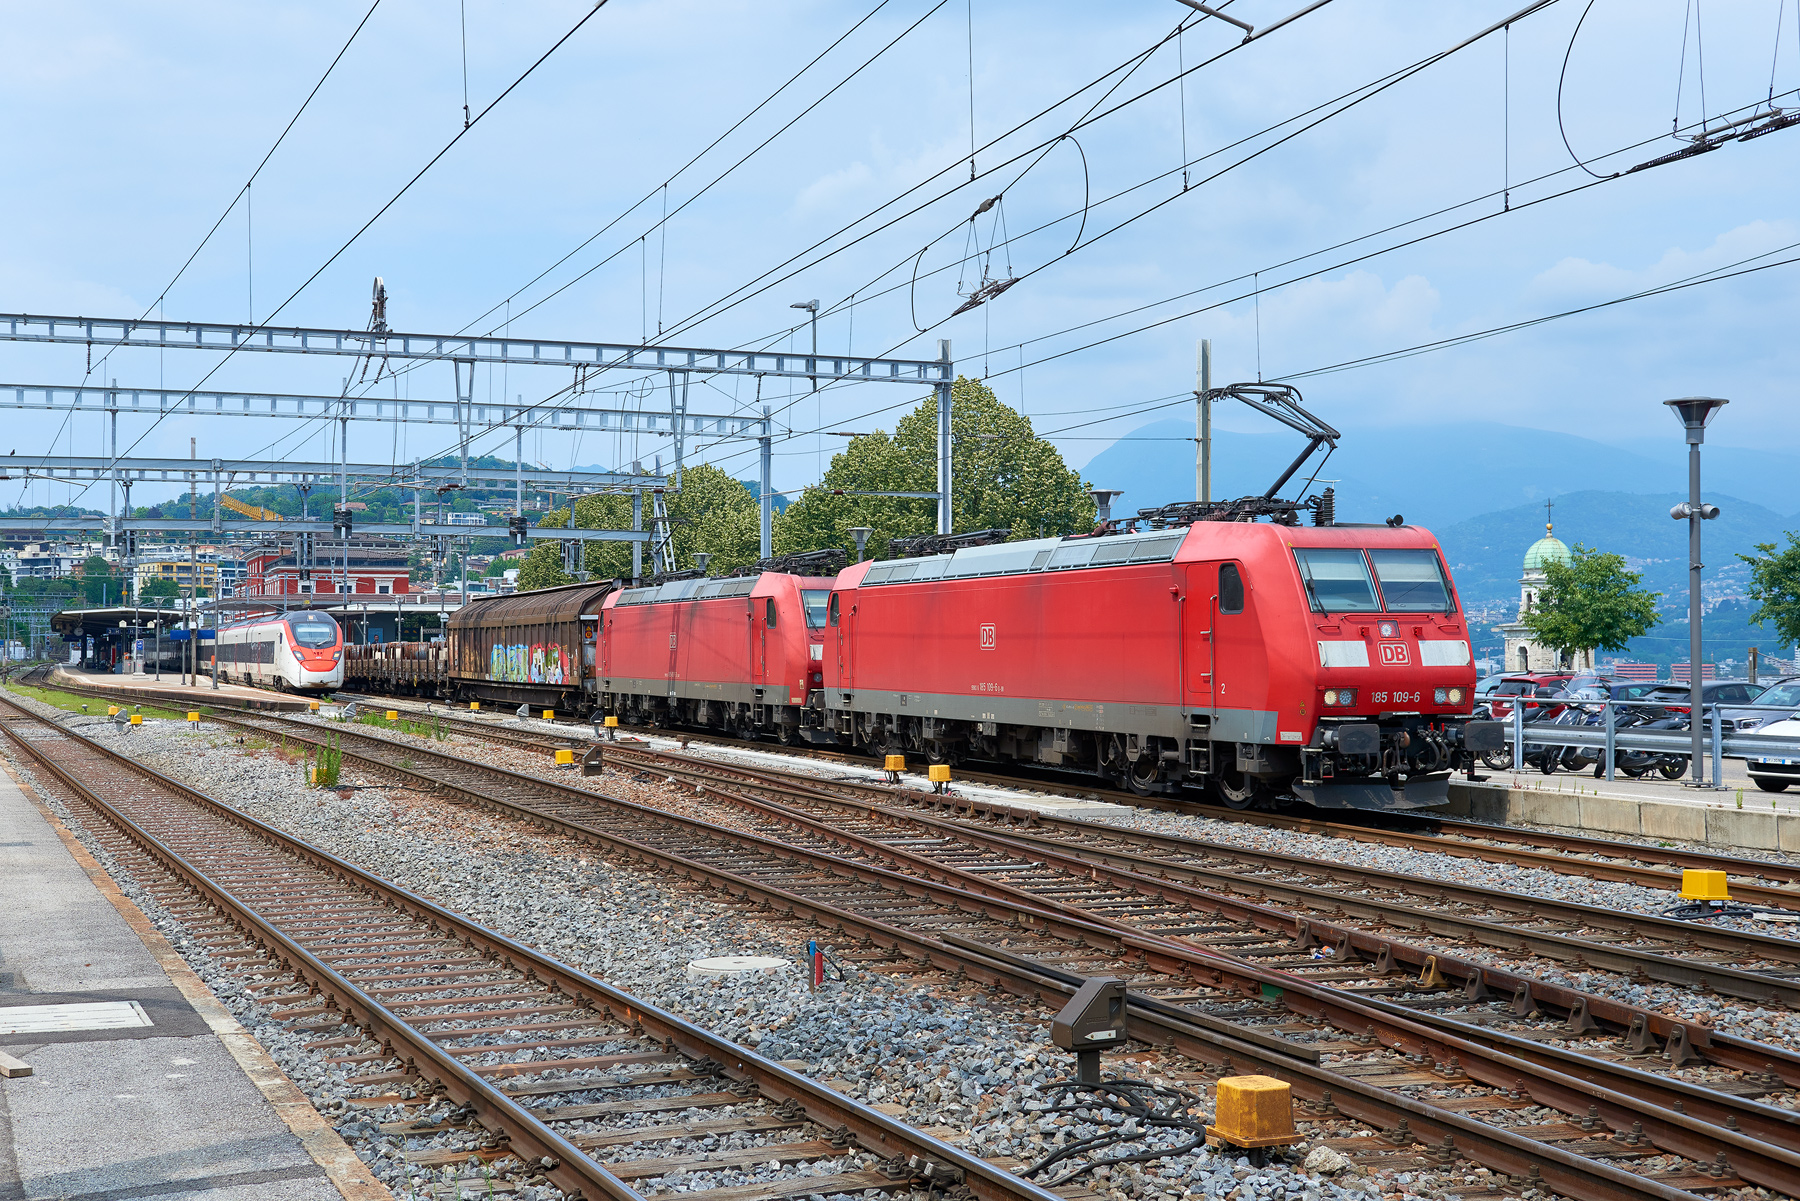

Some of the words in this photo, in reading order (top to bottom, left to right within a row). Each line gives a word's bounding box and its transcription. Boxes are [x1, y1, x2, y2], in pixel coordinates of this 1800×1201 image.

[982, 627, 994, 647] DB
[1380, 644, 1409, 663] DB
[1221, 683, 1226, 694] 2
[1371, 691, 1388, 703] 185
[1393, 691, 1421, 702] 109-6
